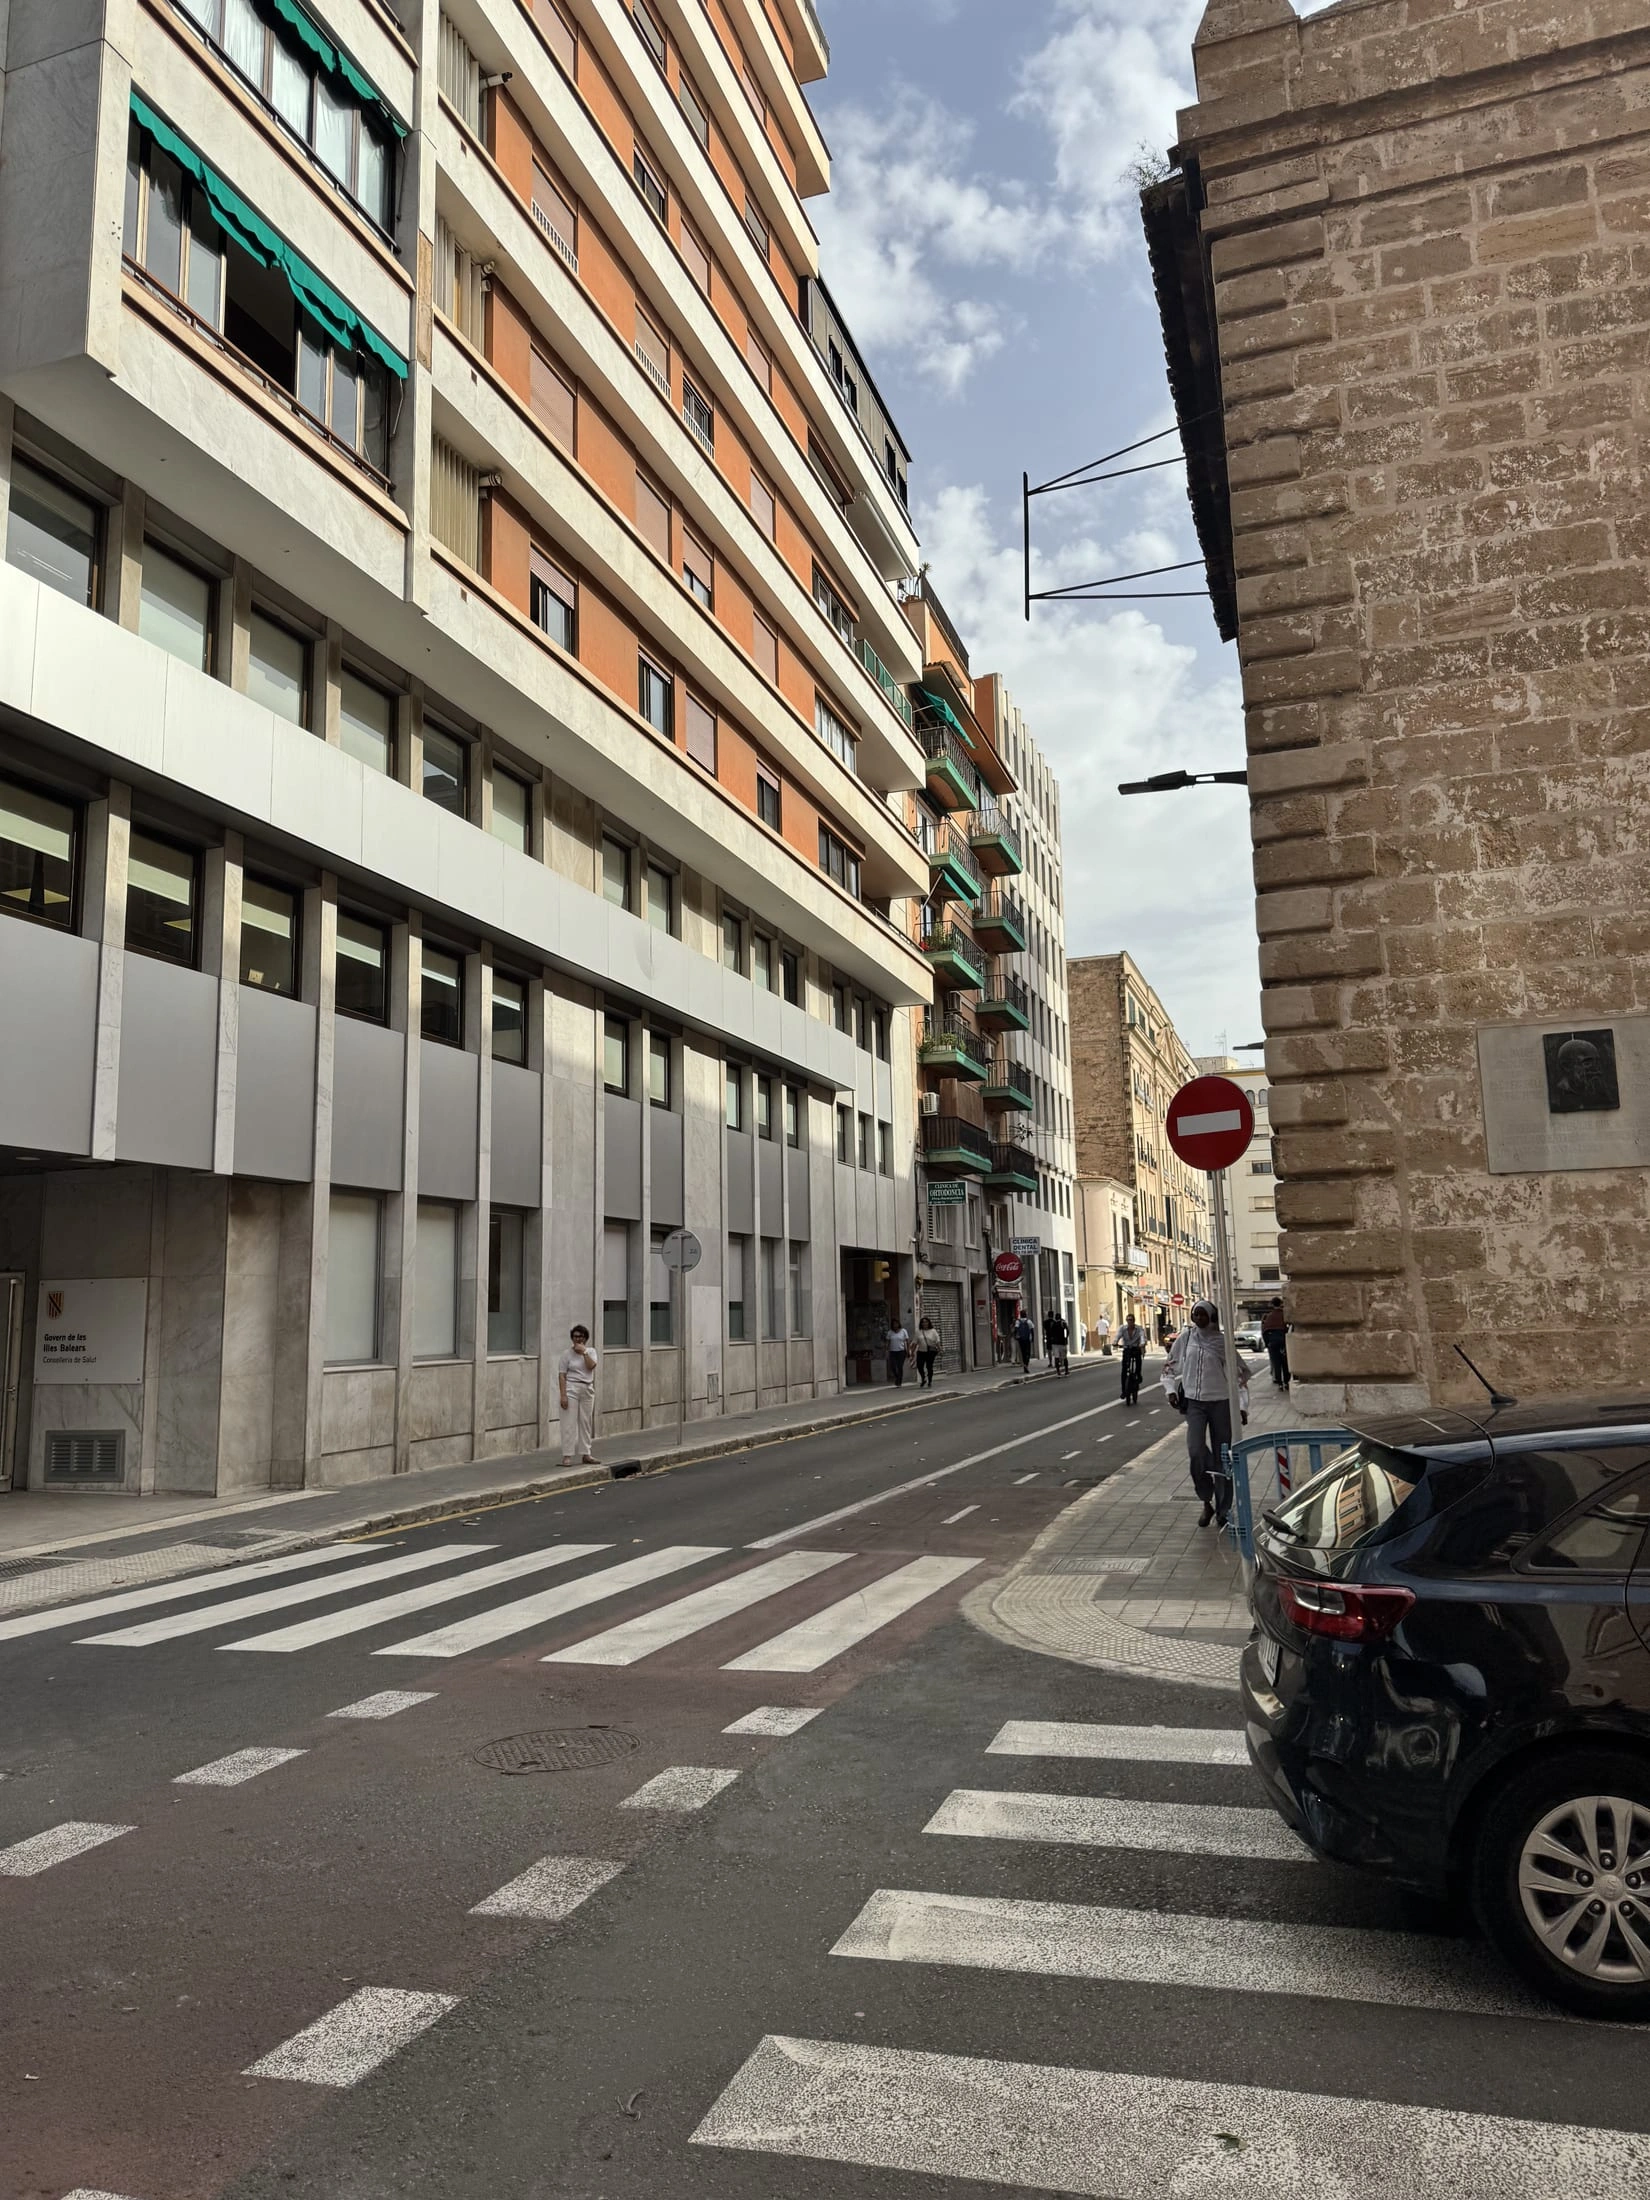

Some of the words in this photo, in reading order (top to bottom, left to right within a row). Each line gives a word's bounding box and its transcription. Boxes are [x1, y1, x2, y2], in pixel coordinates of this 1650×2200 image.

[44, 1333, 66, 1341] Govern
[67, 1333, 76, 1341] de
[77, 1333, 86, 1341] les
[43, 1344, 57, 1352] Illes
[60, 1344, 86, 1352] Balears
